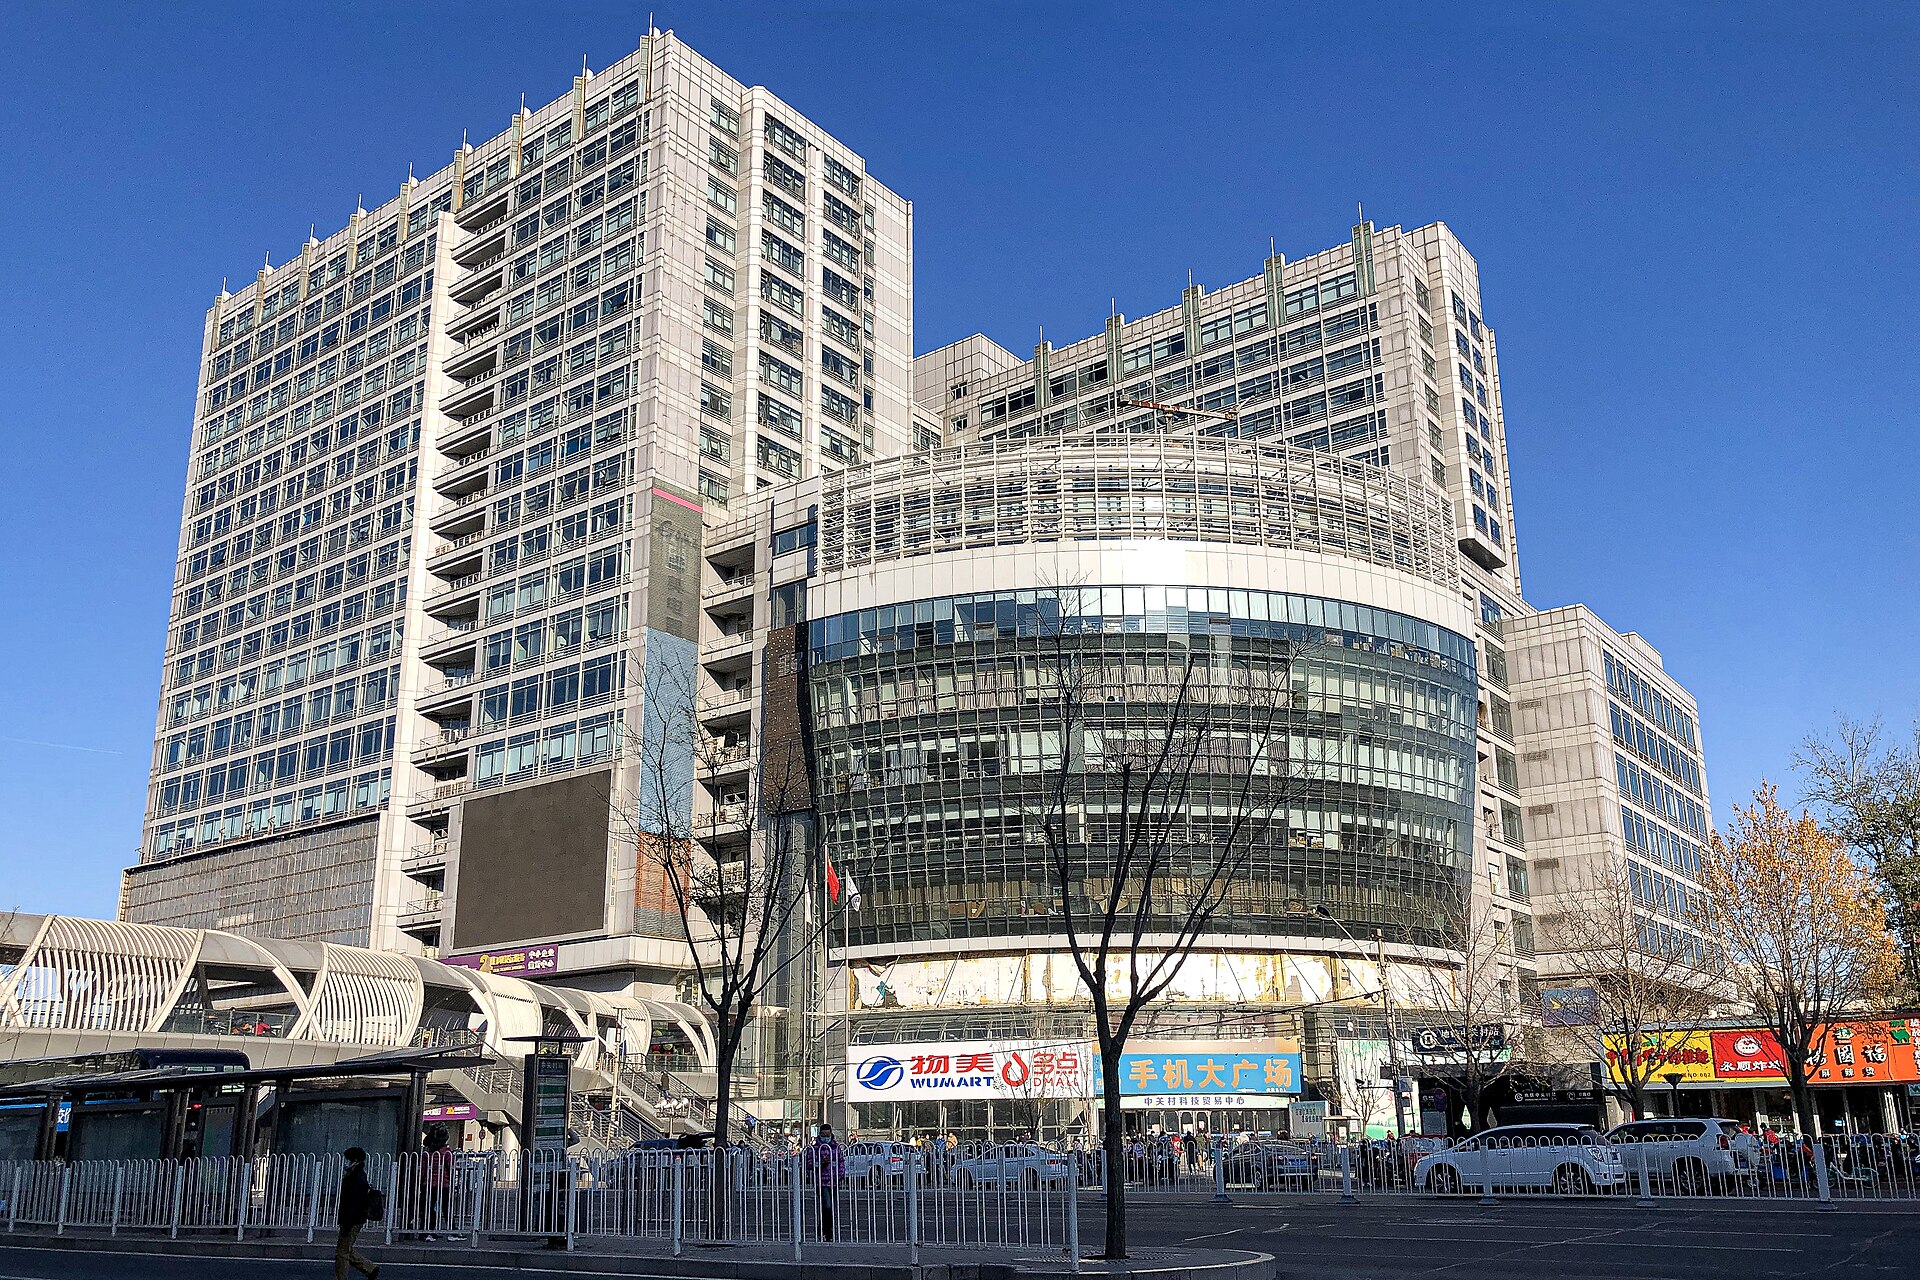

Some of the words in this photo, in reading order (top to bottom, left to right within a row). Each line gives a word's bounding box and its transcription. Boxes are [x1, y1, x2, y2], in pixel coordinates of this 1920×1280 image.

[910, 1053, 994, 1075] 物美
[1033, 1052, 1079, 1075] 多点
[910, 1076, 994, 1089] WUMART
[1033, 1077, 1078, 1087] DMALL
[1128, 1058, 1291, 1090] 手机大广场
[1144, 1096, 1245, 1107] 中关村科技贸易中心
